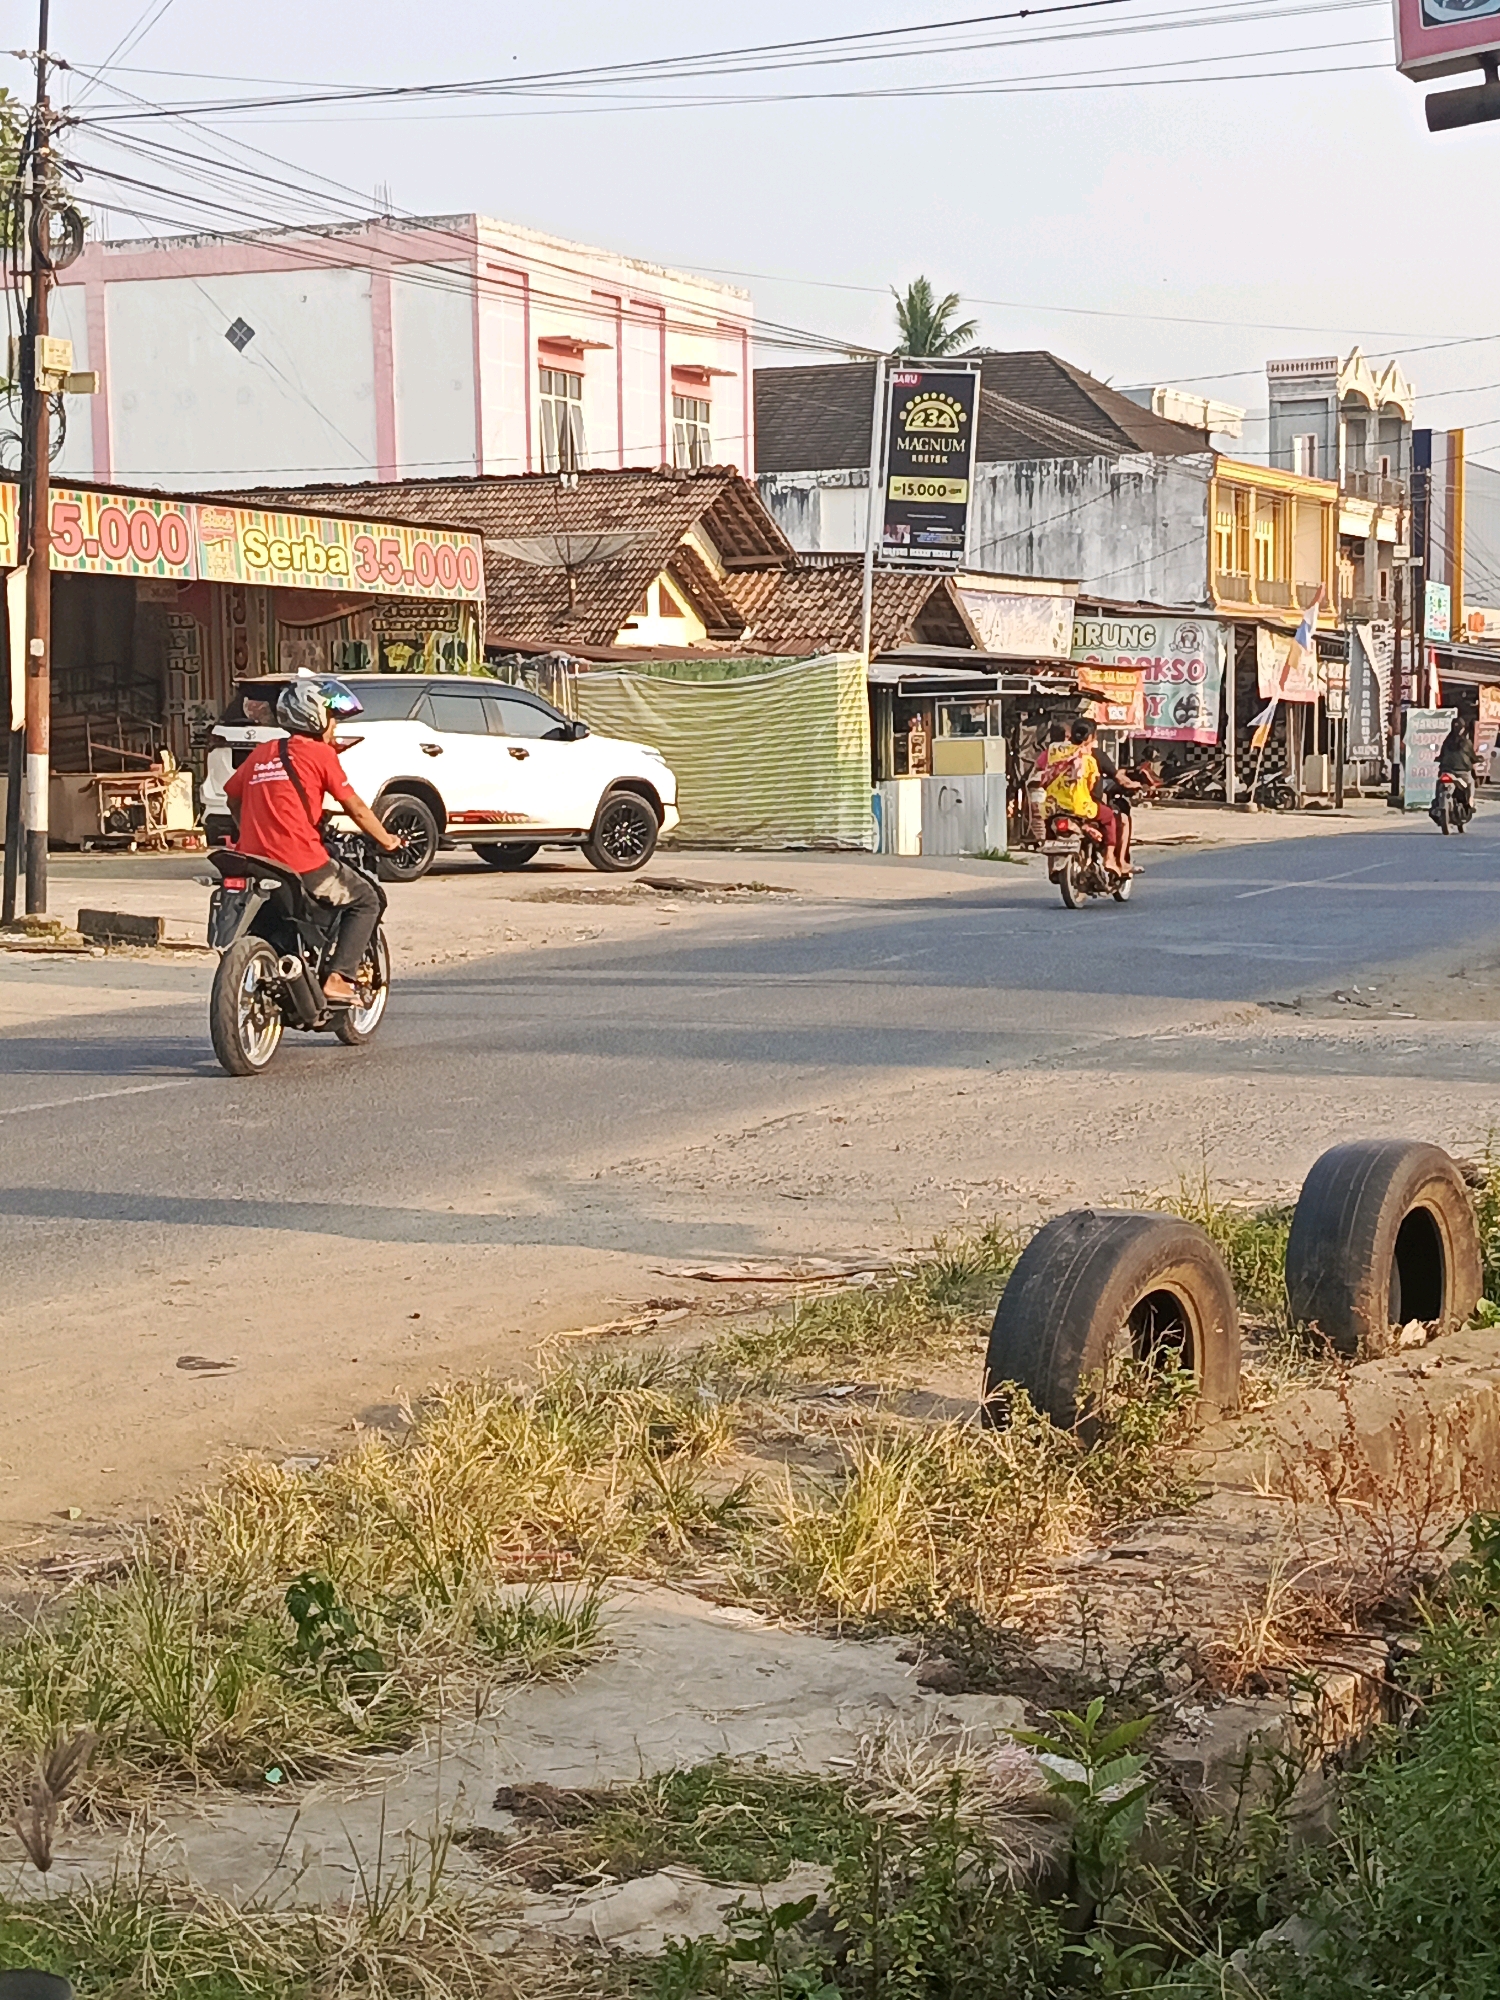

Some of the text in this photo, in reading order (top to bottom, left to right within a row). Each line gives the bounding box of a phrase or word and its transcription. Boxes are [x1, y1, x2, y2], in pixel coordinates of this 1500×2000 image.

[911, 408, 952, 429] 234
[896, 436, 966, 453] MAGNUM
[902, 482, 947, 497] 15.000
[51, 502, 189, 566] 5.000
[243, 528, 350, 576] Serba
[354, 535, 480, 591] 35.000
[1072, 621, 1157, 649] ARUNG
